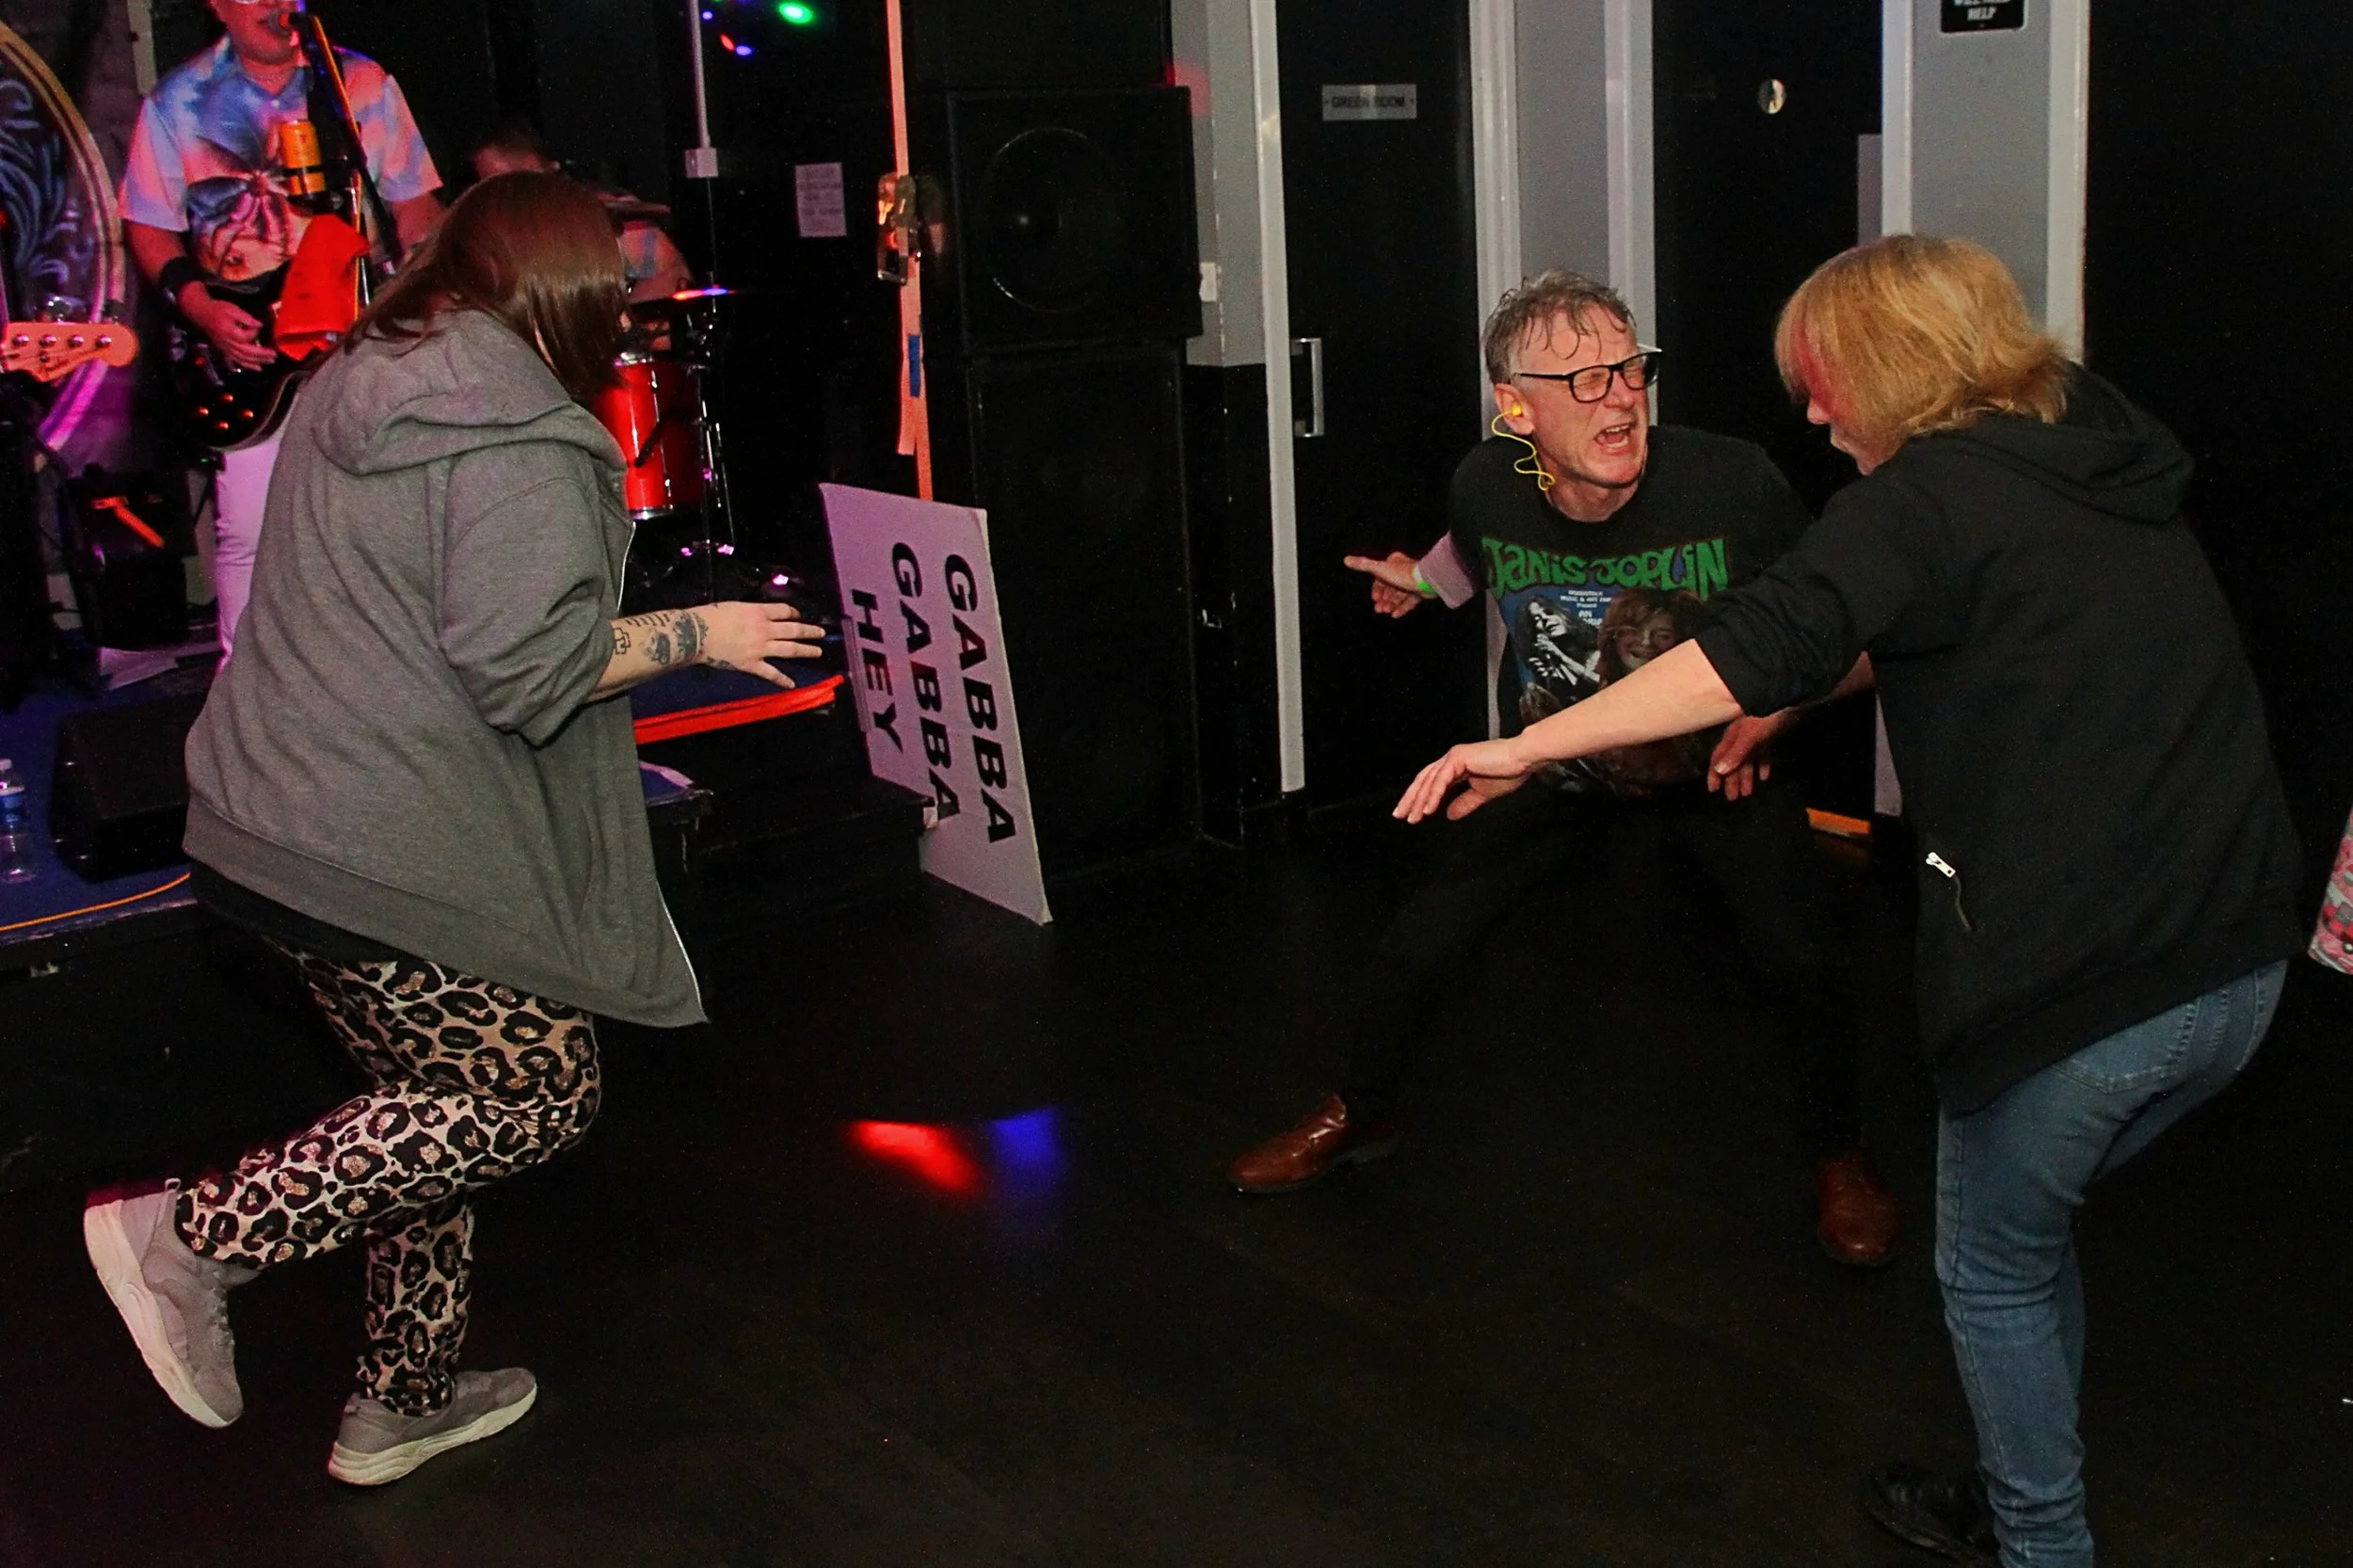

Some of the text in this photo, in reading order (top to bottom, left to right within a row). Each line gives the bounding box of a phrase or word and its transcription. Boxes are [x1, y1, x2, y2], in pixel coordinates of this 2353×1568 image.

[851, 587, 904, 754] HEY
[891, 541, 961, 825] GABBA
[944, 553, 1017, 844] GABBA
